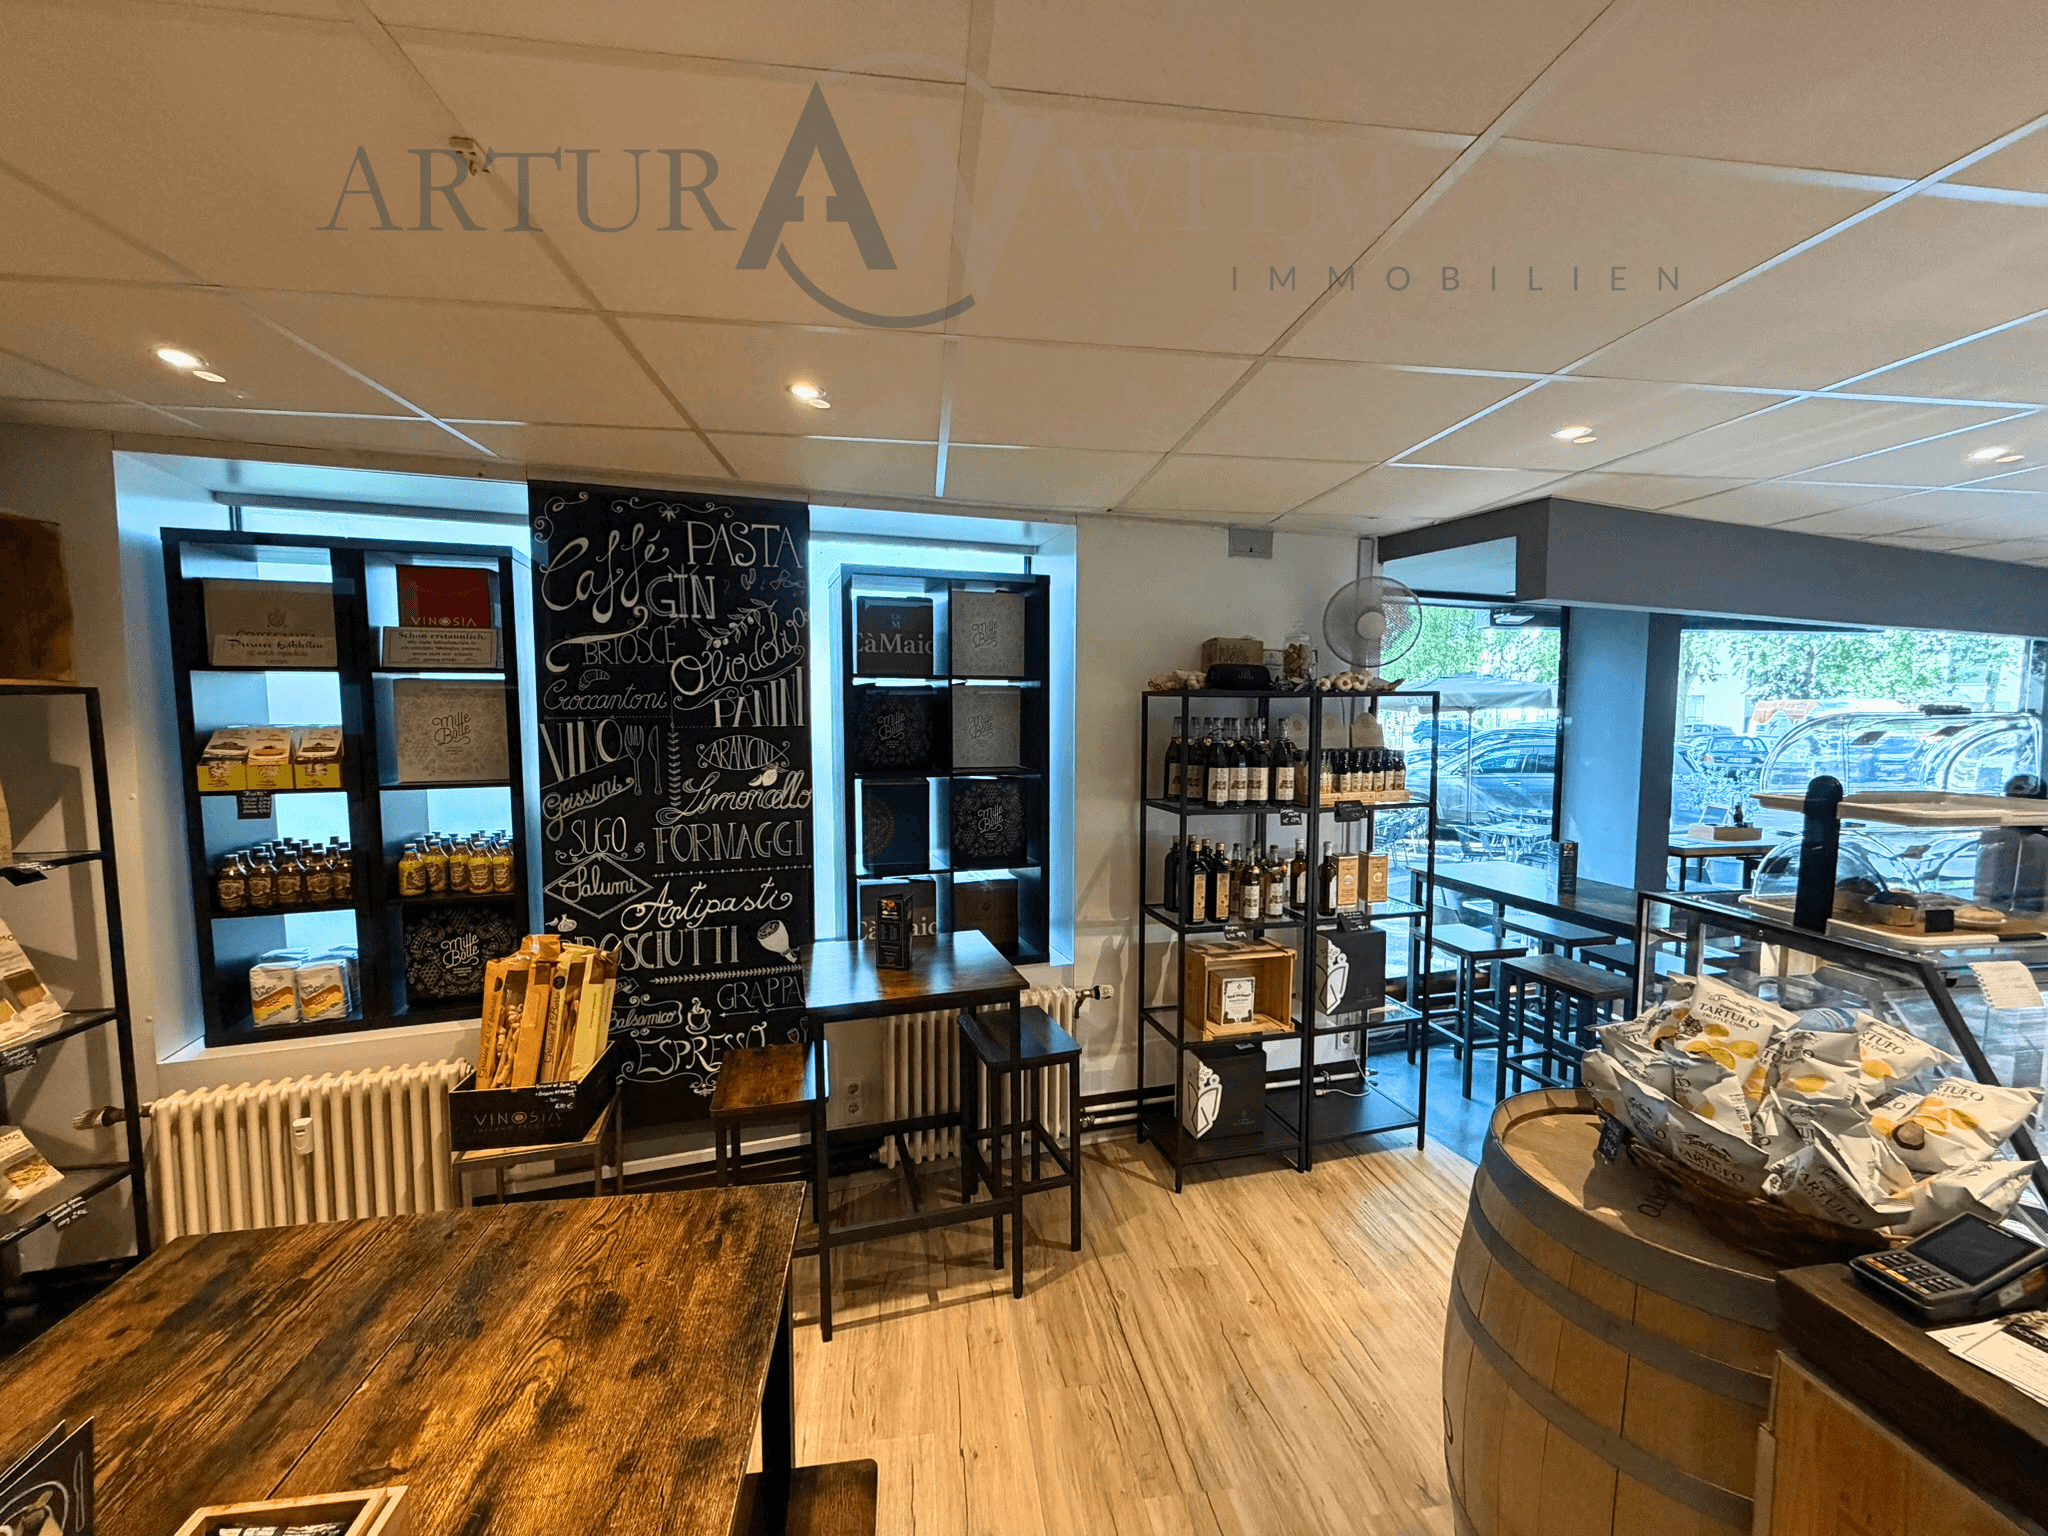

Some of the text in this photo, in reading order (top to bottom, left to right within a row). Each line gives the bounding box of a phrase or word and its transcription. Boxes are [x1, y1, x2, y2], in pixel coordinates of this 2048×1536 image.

[682, 520, 804, 569] PASTA
[645, 573, 716, 620] GIN
[411, 616, 477, 627] VINOSIA
[582, 624, 677, 666] BRIOSCE
[543, 679, 668, 711] Croccantoni
[710, 666, 805, 728] PANINI
[539, 718, 623, 781] VINO
[709, 734, 776, 770] ARANCINI
[655, 769, 813, 825] Limoncello
[570, 816, 628, 858] SUGO
[652, 820, 805, 864] FORMAGGI
[561, 865, 638, 903] Salumi
[621, 876, 793, 931] Antipasti
[440, 932, 480, 951] Mille
[443, 946, 480, 969] Bolle
[716, 975, 806, 1010] GRAPPA
[610, 1008, 677, 1031] Balsamico
[1699, 1001, 1760, 1029] TARTUFO
[474, 1110, 562, 1127] VINOSIA
[1799, 1165, 1863, 1226] ARTUFO
